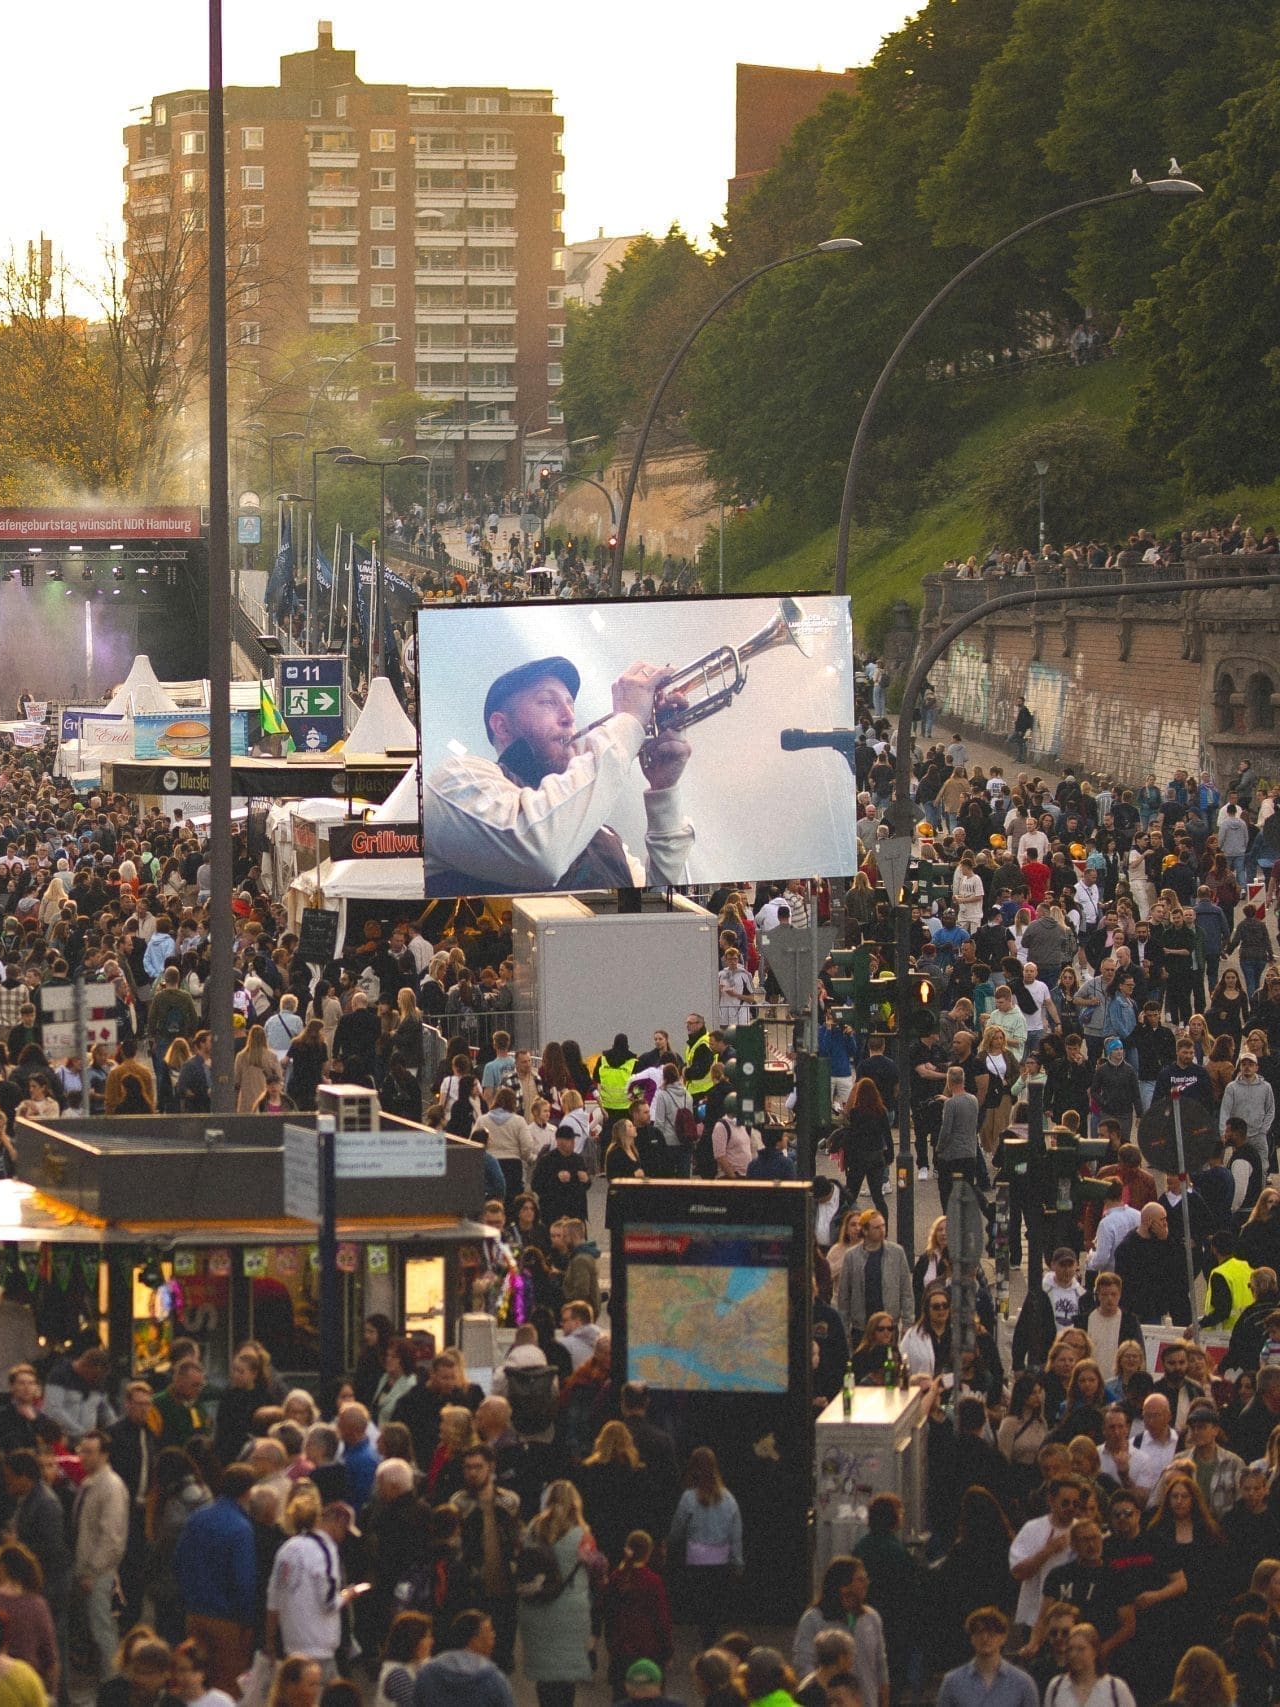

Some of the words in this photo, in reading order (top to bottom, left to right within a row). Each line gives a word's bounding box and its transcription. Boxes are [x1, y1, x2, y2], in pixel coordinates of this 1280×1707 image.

[79, 518, 122, 530] wünscht
[123, 518, 144, 530] NDR
[147, 518, 192, 533] Hamburg
[302, 666, 320, 681] 11
[180, 771, 211, 792] Warstei
[351, 831, 424, 854] Grillwu
